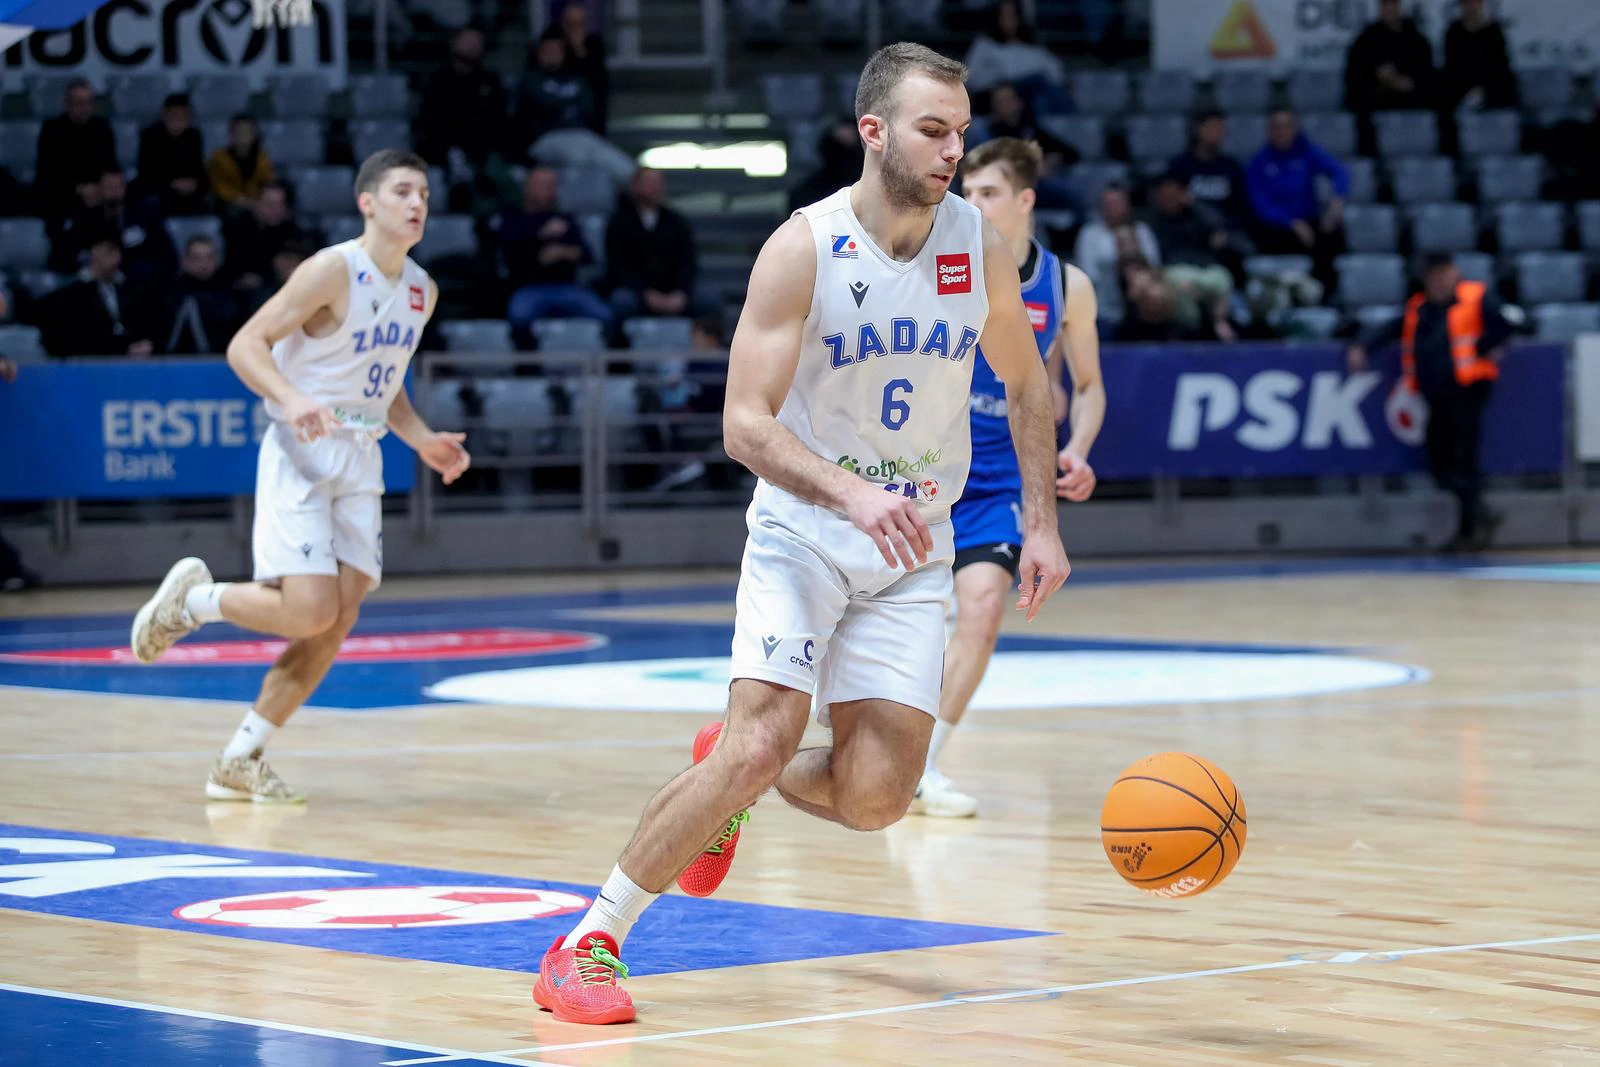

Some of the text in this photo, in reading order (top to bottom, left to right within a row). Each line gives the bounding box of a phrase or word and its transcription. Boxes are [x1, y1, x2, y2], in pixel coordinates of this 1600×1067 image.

[0, 0, 333, 67] acron
[939, 264, 968, 275] Super
[940, 274, 967, 286] Sport
[822, 317, 979, 370] ZADAR
[103, 400, 247, 447] ERSTE
[880, 378, 914, 431] 6
[1167, 369, 1382, 451] PSK
[104, 450, 176, 481] Bank
